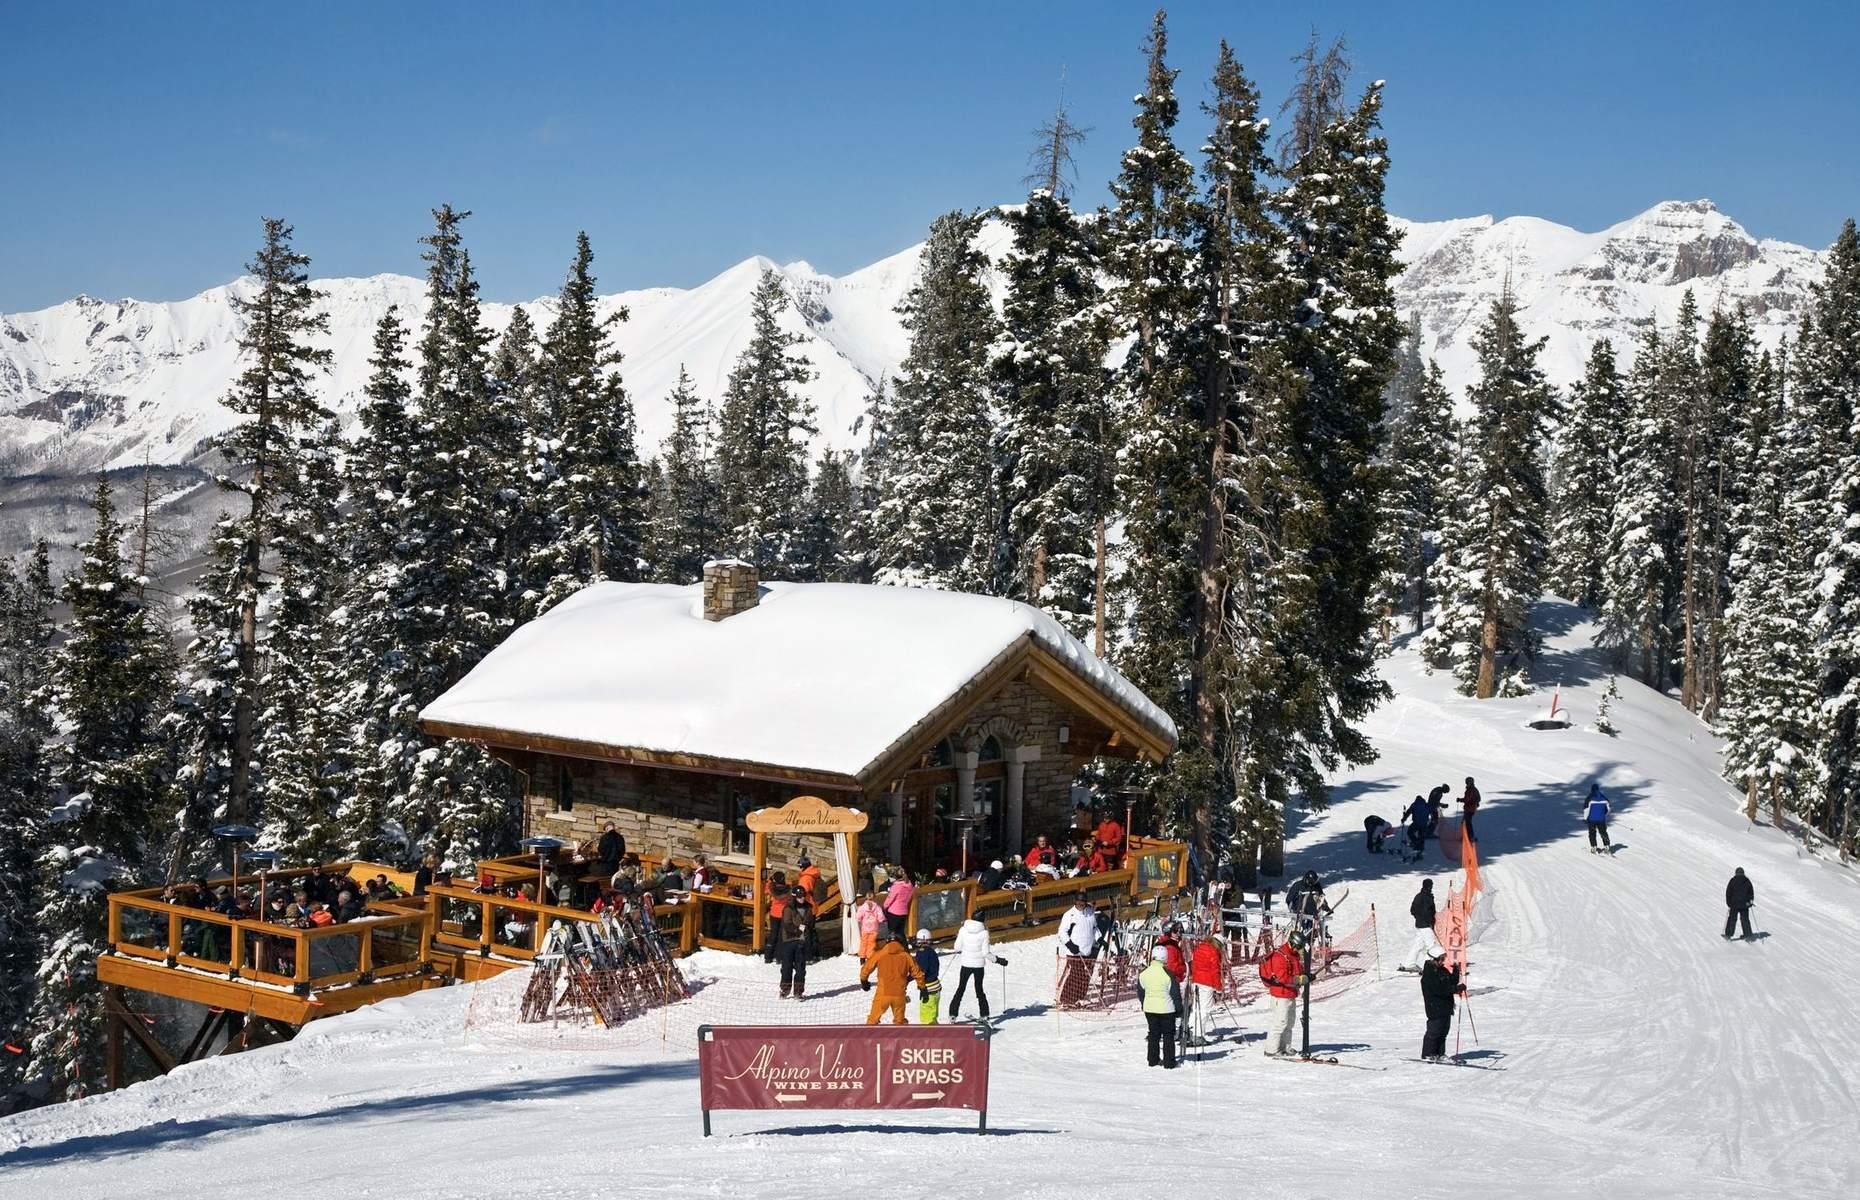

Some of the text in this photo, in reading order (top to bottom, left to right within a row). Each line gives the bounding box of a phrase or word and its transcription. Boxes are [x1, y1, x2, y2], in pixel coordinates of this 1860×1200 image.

[775, 810, 840, 829] Alpino Vino
[900, 1048, 955, 1064] SKIER
[724, 1043, 864, 1089] Alpino Vino
[892, 1068, 963, 1085] BYPASS
[773, 1081, 864, 1090] WINE BAR
